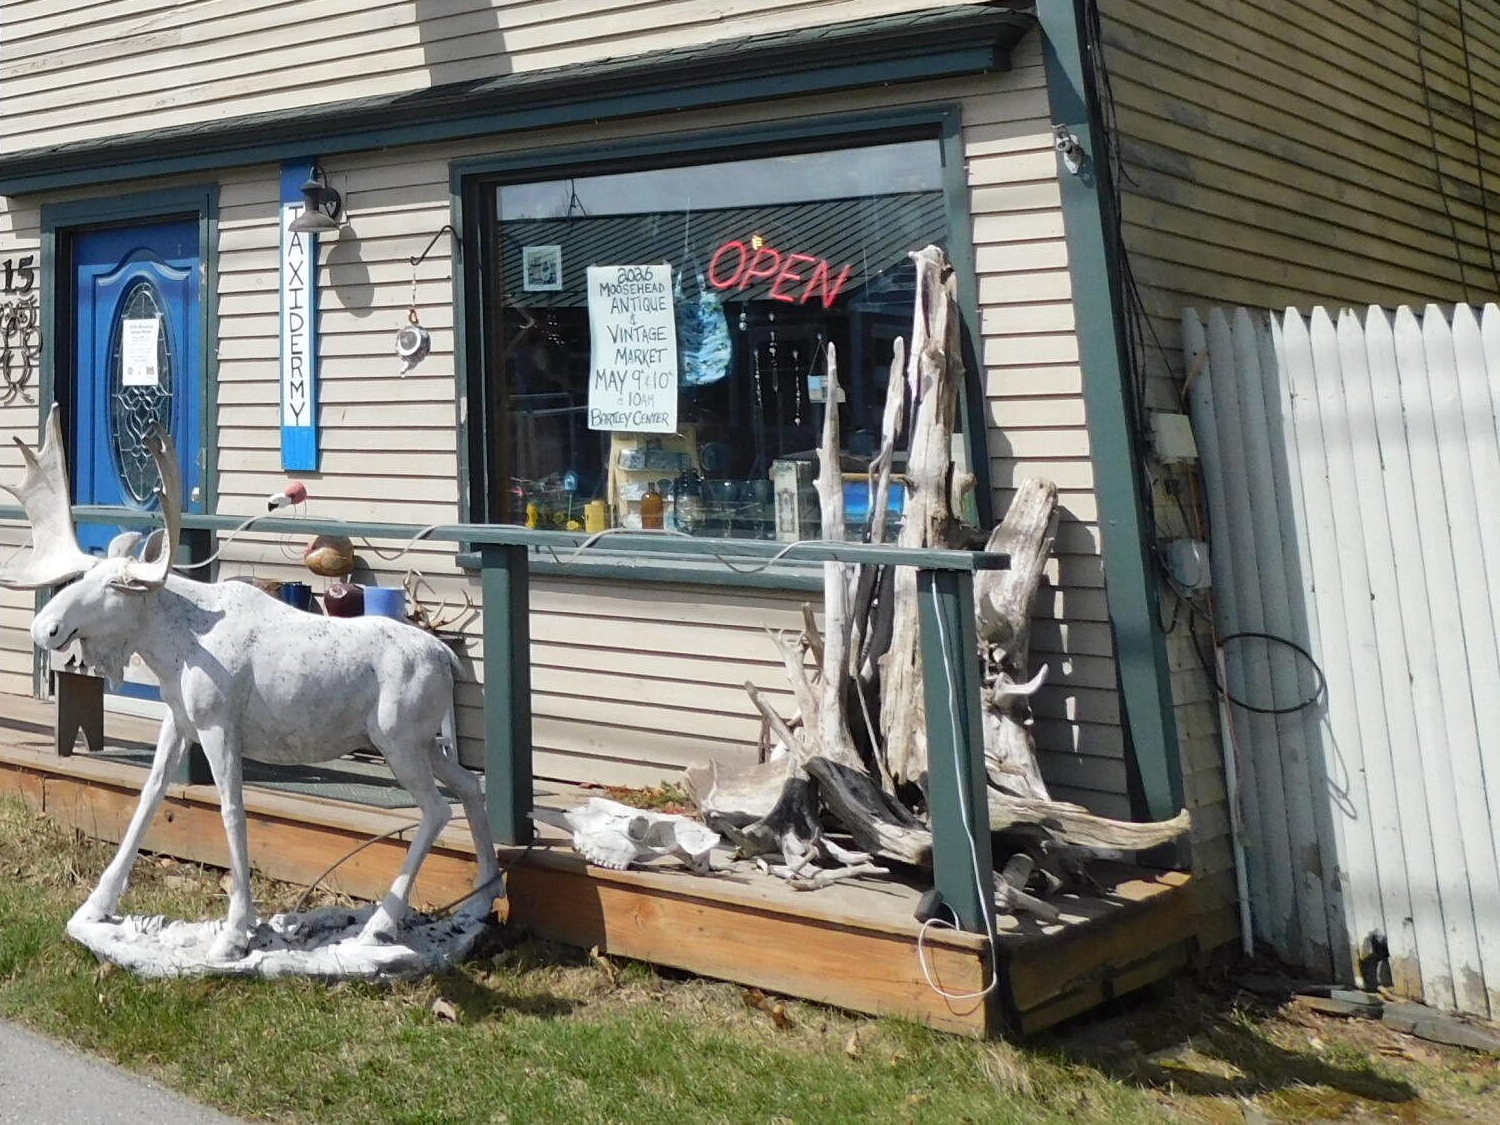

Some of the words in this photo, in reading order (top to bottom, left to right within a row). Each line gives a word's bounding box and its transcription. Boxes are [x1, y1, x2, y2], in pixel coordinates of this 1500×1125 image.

[2, 255, 34, 293] 15
[617, 267, 653, 284] 2026
[709, 240, 851, 309] OPEN
[599, 282, 665, 297] MOOSEHEAD
[610, 296, 667, 315] ANTIQUE
[287, 206, 306, 427] TAXIDERMY
[606, 324, 667, 344] VINTAGE
[614, 347, 668, 368] MARKET
[595, 368, 628, 395] MAY
[632, 410, 669, 426] CENTER
